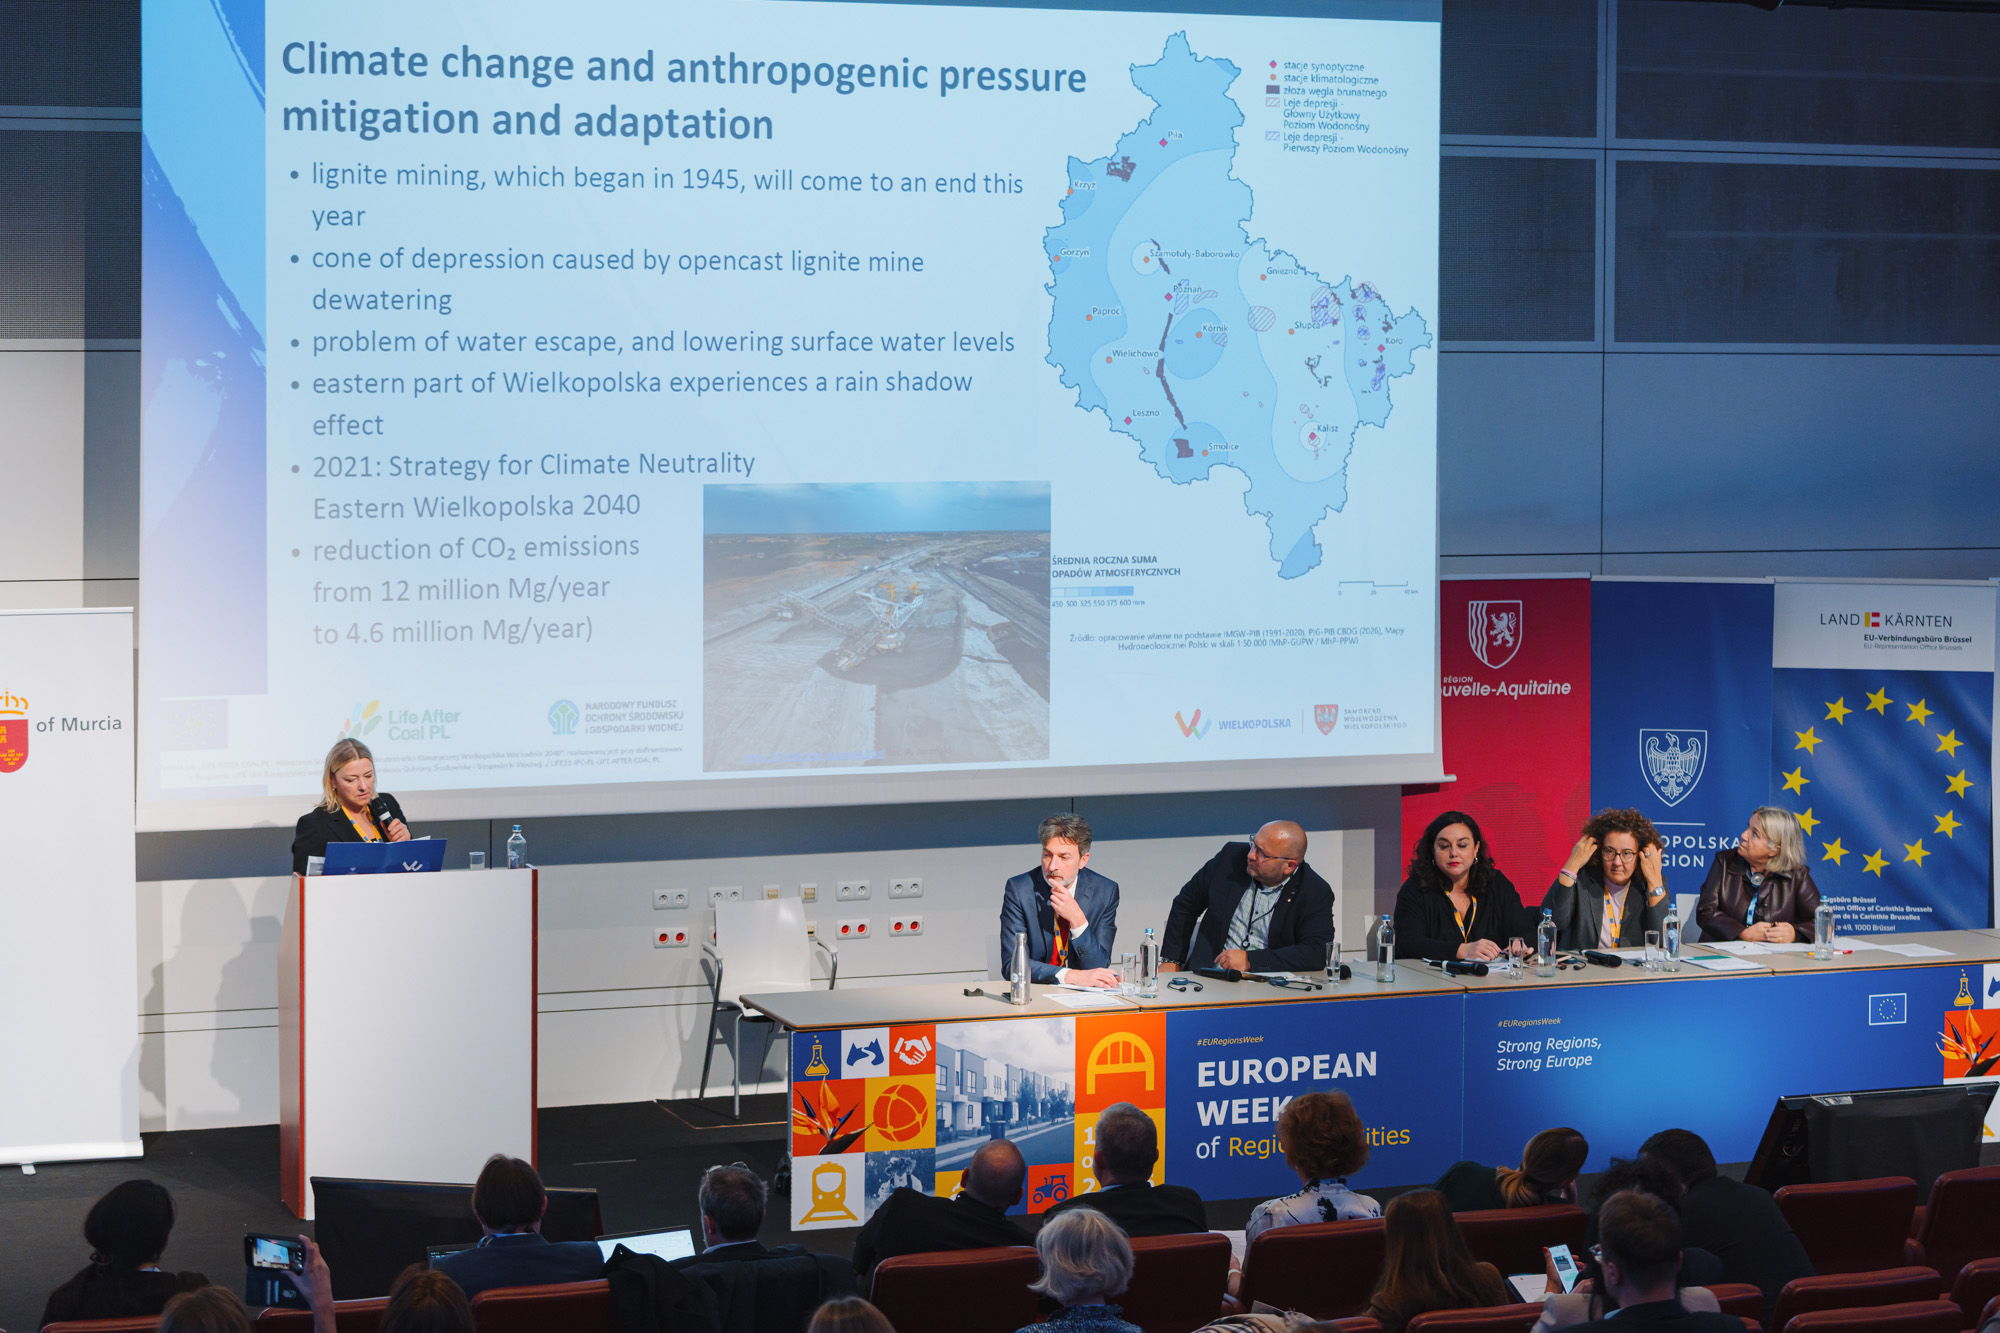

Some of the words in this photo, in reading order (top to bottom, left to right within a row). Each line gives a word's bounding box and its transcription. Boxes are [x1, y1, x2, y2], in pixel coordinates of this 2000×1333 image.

[282, 41, 428, 77] Climate
[442, 45, 574, 87] change
[587, 50, 654, 82] and
[667, 52, 929, 94] anthropogenic
[940, 66, 1087, 97] pressure
[1283, 61, 1308, 71] stacje
[1311, 62, 1365, 72] synoptyczne
[1283, 74, 1308, 84] stacje
[1311, 74, 1379, 86] klimatologiczne
[1309, 87, 1334, 98] węgla
[1337, 88, 1387, 100] brunatnego
[1283, 99, 1301, 109] Leje
[1303, 99, 1338, 110] depresji
[283, 99, 479, 141] mitigation
[492, 103, 561, 136] and
[573, 104, 774, 146] adaptation
[1318, 109, 1360, 122] Użytkowy
[1283, 120, 1315, 130] Poziom
[1283, 132, 1301, 142] Leje
[1303, 132, 1338, 144] depresji
[1283, 143, 1320, 154] Pierwszy
[1323, 144, 1354, 153] Poziom
[312, 162, 387, 190] lignite
[397, 164, 486, 191] mining,
[494, 165, 565, 188] which
[574, 166, 645, 193] began
[654, 167, 674, 189] in
[683, 168, 746, 194] 1945,
[754, 169, 793, 191] will
[800, 175, 862, 192] come
[870, 174, 893, 193] to
[901, 177, 927, 194] an
[935, 173, 976, 193] end
[983, 173, 1023, 194] this
[312, 209, 366, 231] year
[312, 250, 371, 269] cone
[380, 247, 404, 269] of
[411, 247, 544, 277] depression
[553, 249, 634, 270] caused
[643, 249, 671, 275] by
[678, 251, 783, 275] opencast
[791, 250, 861, 276] lignite
[868, 251, 924, 272] mine
[1266, 267, 1299, 275] Gniezno
[312, 288, 452, 316] dewatering
[1202, 324, 1228, 333] Kórnik
[1294, 321, 1320, 330] Słupca
[313, 330, 416, 357] problem
[424, 330, 450, 352] of
[456, 333, 528, 352] water
[534, 332, 623, 356] escape,
[631, 331, 674, 352] and
[683, 330, 784, 357] lowering
[791, 330, 873, 352] surface
[880, 332, 946, 352] water
[953, 331, 1015, 352] levels
[1112, 349, 1159, 357] Wielichowo
[313, 374, 405, 394] eastern
[413, 374, 464, 398] part
[471, 372, 496, 394] of
[503, 371, 661, 397] Wielkopolska
[670, 372, 808, 397] experiences
[815, 376, 828, 392] a
[835, 372, 878, 392] rain
[886, 371, 973, 392] shadow
[1132, 409, 1160, 417] Leszno
[313, 413, 384, 436] effect
[1208, 442, 1239, 451] Smolice
[313, 456, 382, 478] 2021:
[389, 456, 490, 482] Strategy
[498, 453, 533, 476] for
[540, 453, 631, 476] Climate
[638, 452, 755, 477] Neutrality
[313, 497, 405, 520] Eastern
[413, 494, 574, 521] Wielkopolska
[582, 494, 641, 516] 2040
[313, 538, 431, 561] reduction
[439, 537, 465, 560] of
[524, 535, 640, 558] emissions
[1052, 555, 1090, 565] ŚREDNIA
[1093, 556, 1129, 565] ROCZNA
[1131, 555, 1157, 564] SUMA
[1052, 568, 1092, 578] OPADÓW
[1094, 568, 1181, 578] ATMOSFERYCZNYCH
[313, 580, 371, 603] from
[381, 580, 410, 602] 12
[418, 577, 500, 601] million
[508, 575, 610, 603] Mg/year
[1820, 613, 1860, 626] LAND
[1885, 612, 1952, 627] KÄRNTEN
[313, 624, 338, 645] to
[346, 622, 384, 644] 4.6
[392, 619, 473, 643] million
[483, 616, 592, 645] Mg/year)
[1864, 634, 1942, 643] EU-Verbindungsbüro
[1944, 635, 1972, 643] Brüssel
[1443, 675, 1473, 683] RÉGION
[1440, 680, 1571, 701] uvelle-Aquitaine
[585, 701, 634, 711] NARODOWY
[637, 699, 677, 709] FUNDUSZ
[388, 709, 418, 724] Life
[421, 708, 461, 724] After
[36, 717, 55, 732] of
[62, 716, 122, 731] Murcia
[1218, 718, 1291, 730] WIELKOPOLSKA
[388, 726, 425, 741] Coal
[429, 725, 451, 740] PL
[1660, 835, 1740, 850] OPOLSKA
[1661, 854, 1704, 868] GION
[1872, 924, 1896, 932] Brüssel
[1498, 1017, 1561, 1028] #EURegionsWeek
[1196, 1035, 1264, 1047] #EURegionsWeek
[1496, 1040, 1541, 1054] Strong
[1546, 1036, 1601, 1052] Regions,
[1198, 1051, 1377, 1088] EUROPEAN
[1496, 1057, 1541, 1072] Strong
[1546, 1055, 1593, 1069] Europe
[1196, 1136, 1221, 1160] of
[1229, 1134, 1284, 1160] Regi
[1366, 1126, 1411, 1146] ities
